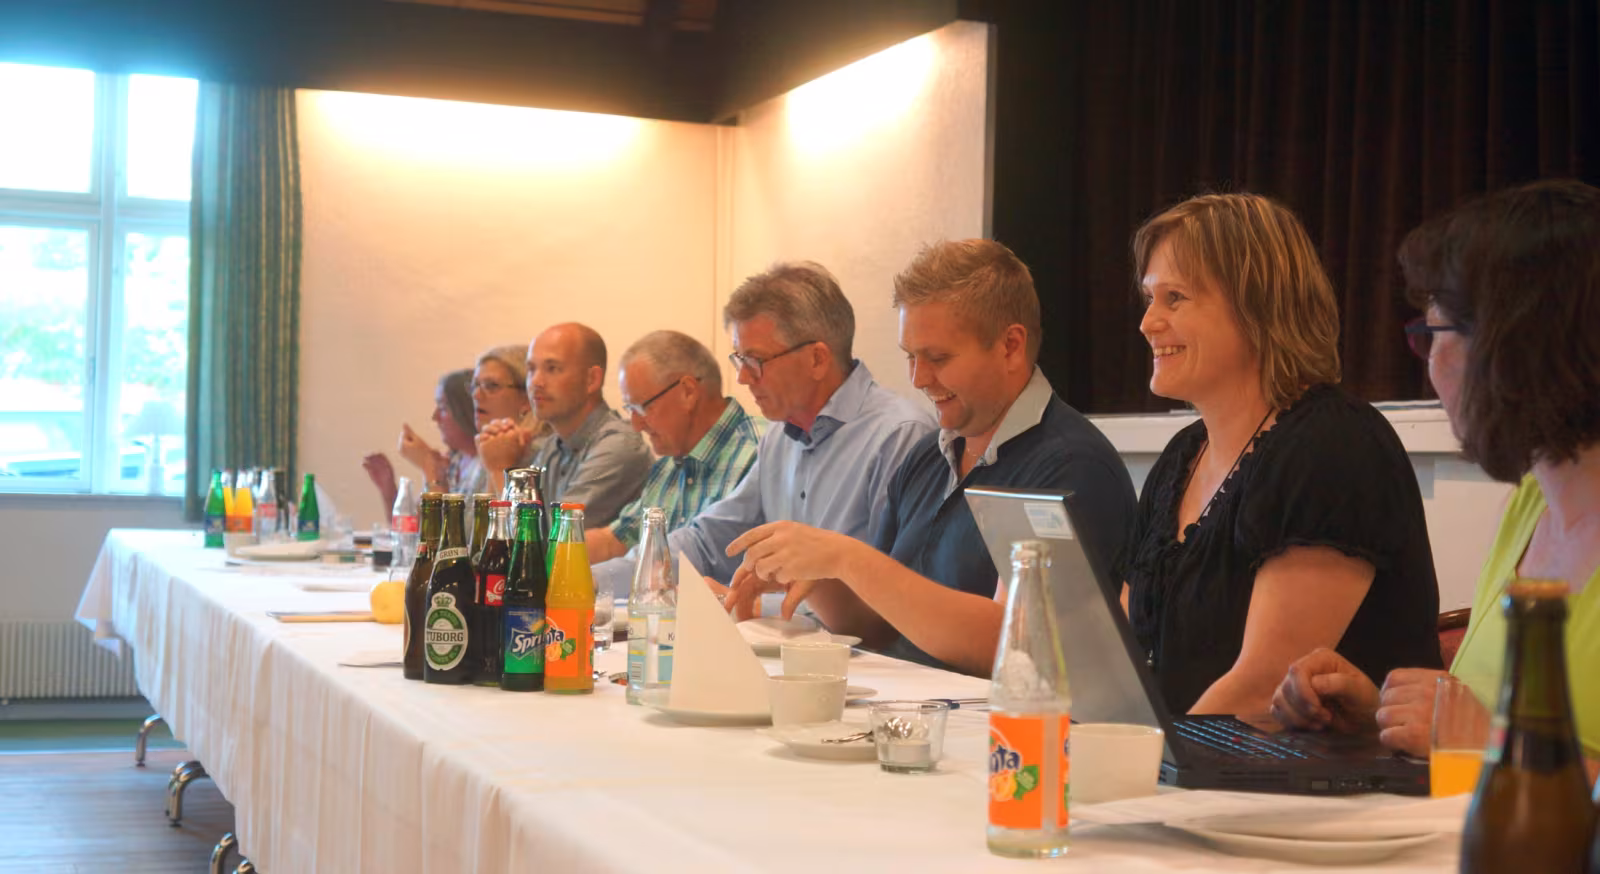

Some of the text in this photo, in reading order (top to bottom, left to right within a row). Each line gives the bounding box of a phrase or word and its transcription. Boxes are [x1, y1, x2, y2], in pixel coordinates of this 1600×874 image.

[427, 632, 464, 642] TUBORG
[512, 633, 543, 654] Spri
[544, 628, 565, 645] nta
[989, 744, 1020, 773] nta
